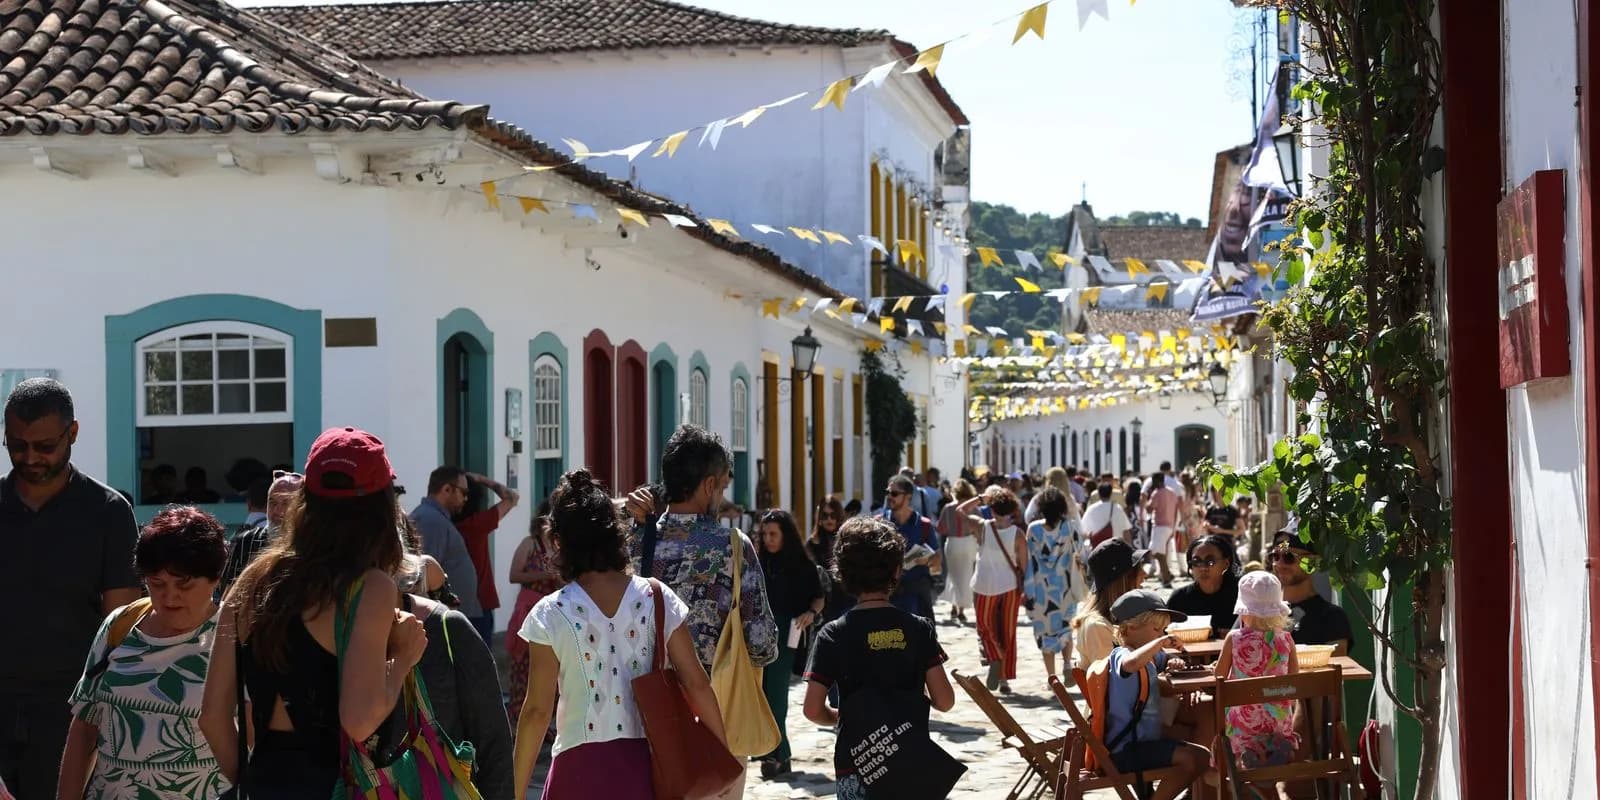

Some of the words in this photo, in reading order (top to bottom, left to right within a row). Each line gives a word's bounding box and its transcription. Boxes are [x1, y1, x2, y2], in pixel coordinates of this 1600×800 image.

[854, 732, 894, 766] carregar
[894, 721, 913, 736] um
[868, 724, 889, 744] pra
[858, 754, 885, 776] tanto
[885, 743, 899, 757] de
[863, 766, 889, 785] trem
